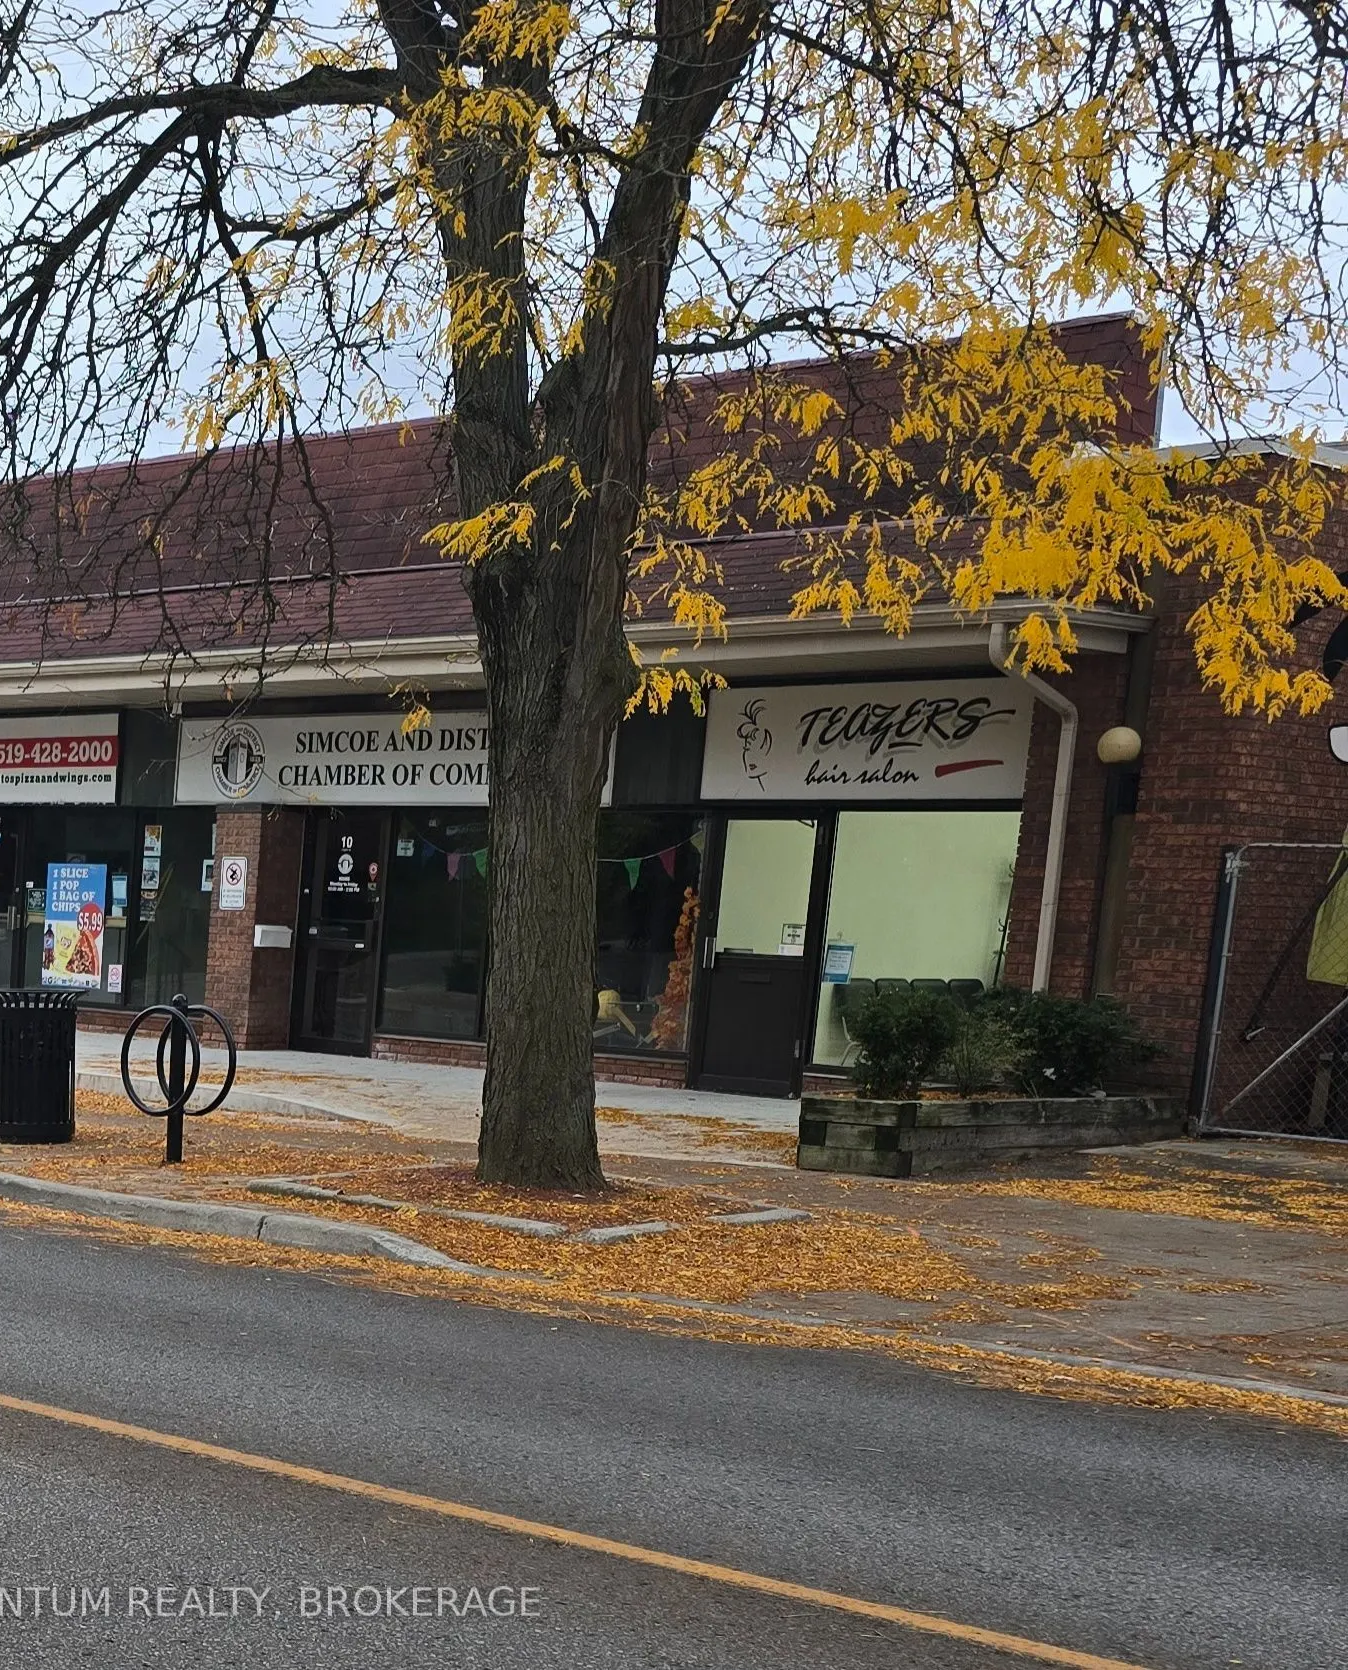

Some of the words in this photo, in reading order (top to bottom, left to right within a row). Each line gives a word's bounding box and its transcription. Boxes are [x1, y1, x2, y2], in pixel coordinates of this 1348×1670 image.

[800, 697, 1016, 755] TEAZERS
[295, 730, 379, 753] SIMCOE
[384, 729, 433, 752] AND
[438, 728, 489, 751] DIST
[278, 764, 384, 787] CHAMBER
[392, 763, 424, 786] OF
[429, 763, 489, 786] COM
[804, 759, 852, 786] hair
[852, 758, 919, 784] salon
[341, 836, 354, 848] 10
[60, 867, 89, 879] SLICE
[59, 880, 80, 891] POP
[59, 891, 80, 901] BAG
[82, 891, 96, 902] OF
[51, 902, 81, 912] CHIPS
[78, 912, 103, 931] $5.99
